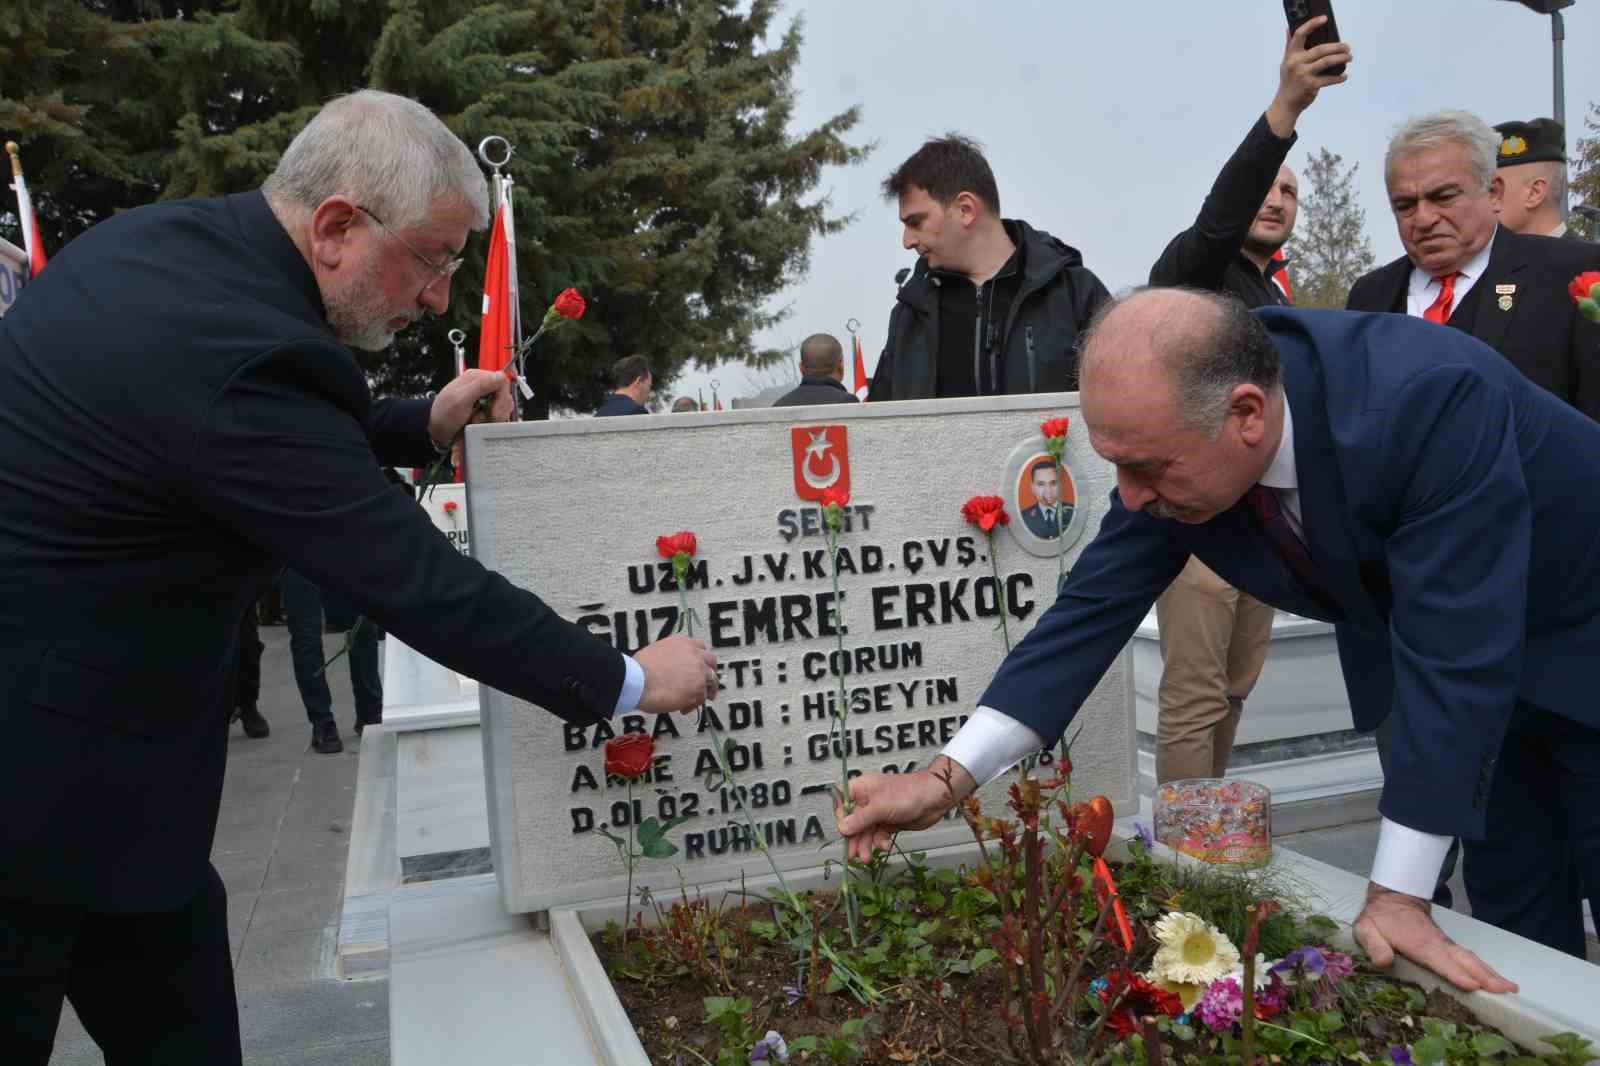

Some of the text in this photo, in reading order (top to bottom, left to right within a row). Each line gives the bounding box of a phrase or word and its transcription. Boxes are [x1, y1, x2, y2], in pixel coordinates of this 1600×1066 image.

[708, 592, 848, 648] EMRE
[872, 573, 1035, 631] ERKOÇ
[803, 641, 923, 682] ÇORUM
[563, 712, 681, 751] BABA
[694, 742, 763, 778] ADI
